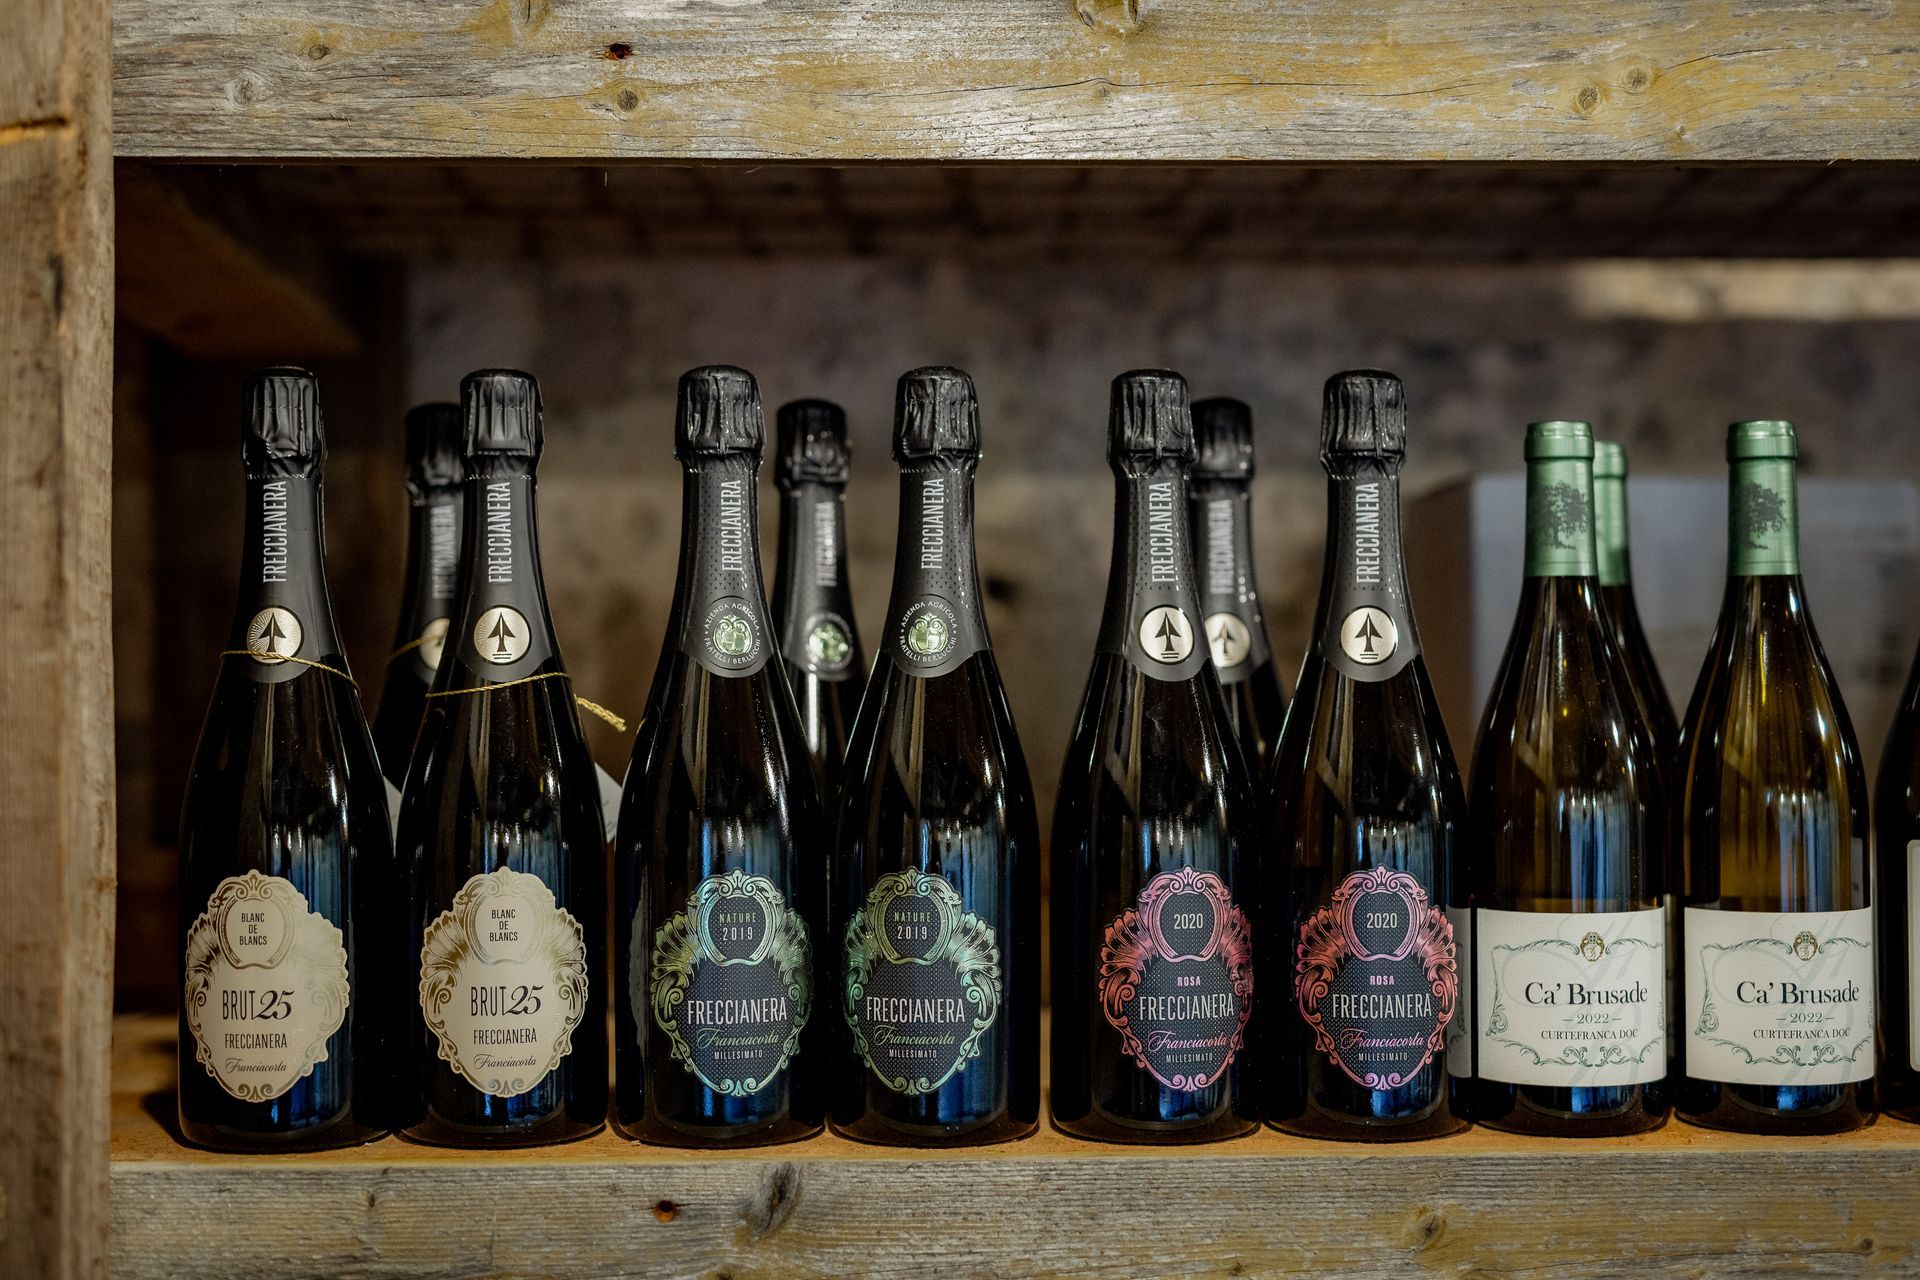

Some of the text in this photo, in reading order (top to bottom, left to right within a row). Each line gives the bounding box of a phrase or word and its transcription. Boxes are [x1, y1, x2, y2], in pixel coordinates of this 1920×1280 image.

[263, 480, 287, 583] FRECCIANERA
[487, 481, 513, 583] FRECCIANERA
[721, 480, 742, 571] FRECCIANERA
[921, 478, 944, 569] FRECCIANERA
[1149, 481, 1175, 582] FRECCIANERA
[1355, 482, 1380, 583] FRECCIANERA
[704, 602, 760, 630] AZIENDA AGRICOLA
[901, 600, 958, 629] AZIENDA AGRICOLA
[703, 637, 761, 664] FRATELLI BERLUCCHI
[899, 635, 957, 662] FRATELLI BERLUCCHI
[241, 912, 265, 923] BLANC
[491, 908, 516, 919] BLANC
[719, 912, 757, 924] NATURE
[894, 911, 931, 923] NATURE
[1173, 913, 1204, 930] 2020
[1366, 913, 1398, 929] 2020
[248, 924, 258, 934] DE
[498, 920, 509, 930] DE
[722, 926, 753, 941] 2019
[897, 925, 928, 940] 2019
[239, 935, 268, 946] BLANCS
[489, 931, 518, 942] BLANCS
[1177, 976, 1201, 987] ROSA
[1369, 975, 1395, 986] ROSA
[1524, 981, 1648, 1005] Ca' Brusade
[1736, 980, 1860, 1004] Ca' Brusade
[222, 989, 295, 1020] BRUT 25
[470, 985, 545, 1017] BRUT 25
[866, 996, 965, 1023] FRECCIANERA
[1139, 993, 1234, 1021] FRECCIANERA
[1332, 993, 1432, 1019] FRECCIANERA
[687, 997, 788, 1025] FRECCIANERA
[1577, 1013, 1610, 1024] 2022
[1789, 1012, 1823, 1023] 2022
[224, 1033, 287, 1049] FRECCIANERA
[473, 1028, 537, 1045] FRECCIANERA
[697, 1027, 780, 1049] Franciacorta
[873, 1024, 955, 1046] Franciacorta
[1147, 1030, 1228, 1052] Franciacorta
[1340, 1027, 1424, 1050] Franciacorta
[1541, 1028, 1639, 1040] CURTEFRANCA DOC
[1753, 1027, 1851, 1039] CURTEFRANCA DOC
[473, 1053, 537, 1070] Franciacorta
[714, 1050, 763, 1060] MILLESIMATO
[889, 1049, 937, 1059] MILLESIMATO
[1165, 1053, 1213, 1063] MILLESIMATO
[1358, 1052, 1408, 1062] MILLESIMATO
[224, 1057, 287, 1074] Franciacorta
